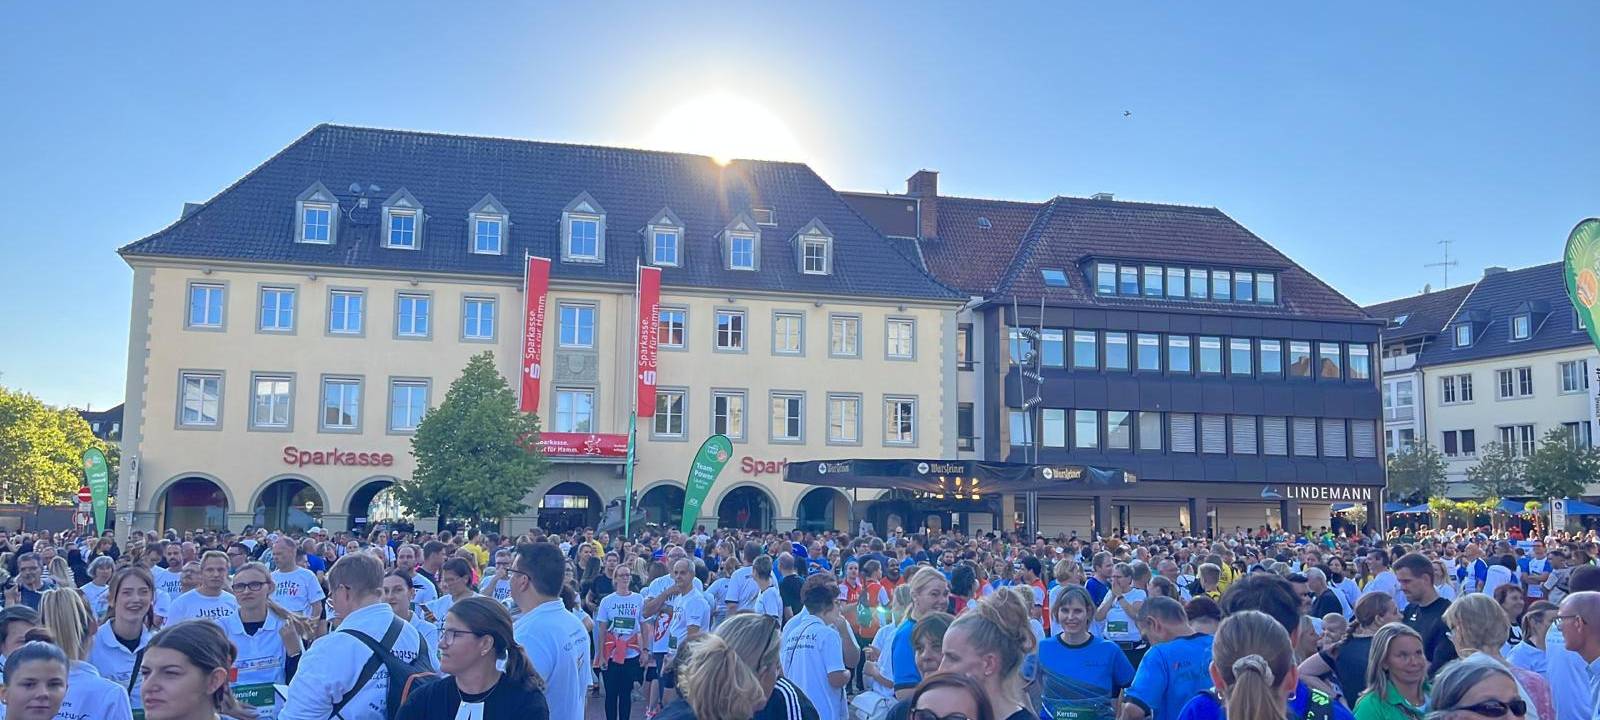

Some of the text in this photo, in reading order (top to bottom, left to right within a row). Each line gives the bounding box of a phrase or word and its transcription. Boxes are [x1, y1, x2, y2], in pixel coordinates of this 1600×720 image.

[639, 316, 649, 366] Sparkasse.
[283, 446, 394, 467] Sparkasse
[1286, 486, 1372, 500] LINDEMANN
[1056, 710, 1078, 718] Kerstin
